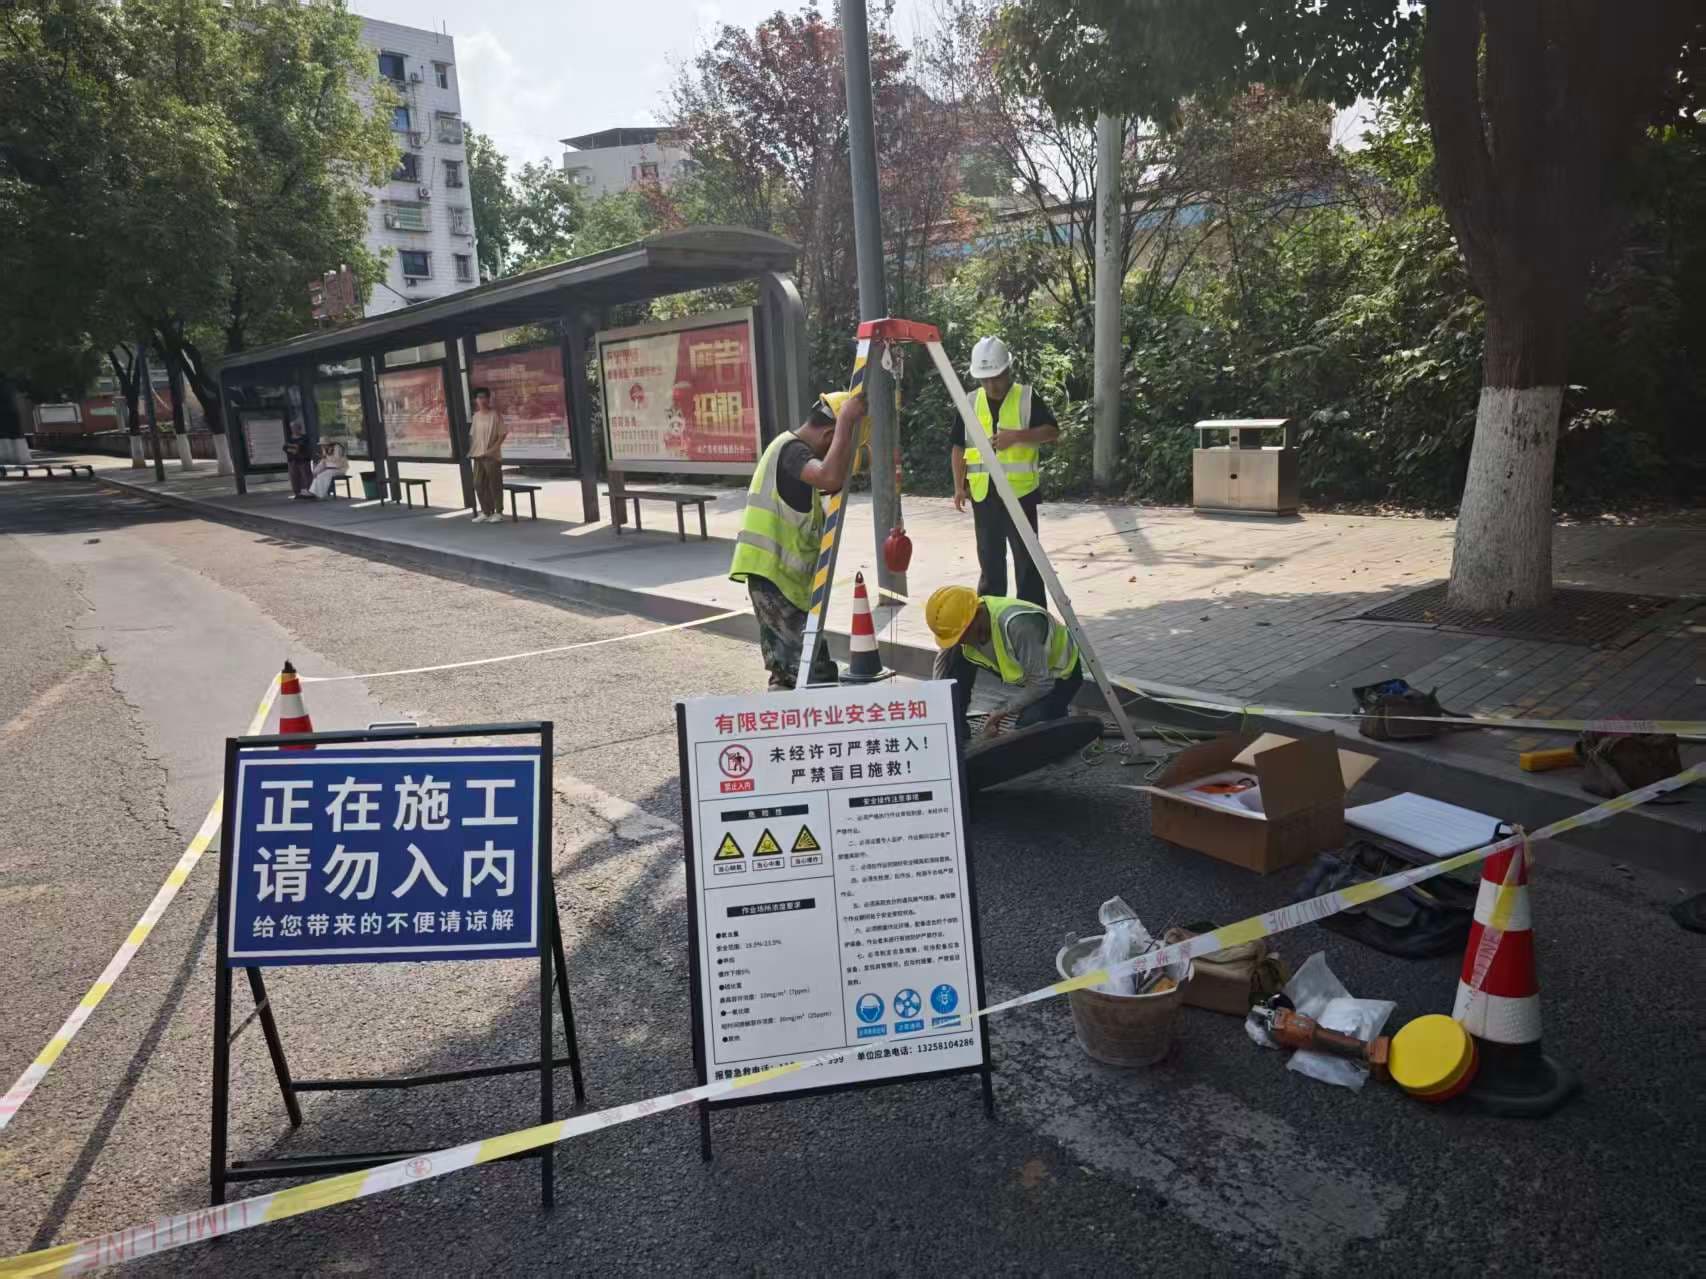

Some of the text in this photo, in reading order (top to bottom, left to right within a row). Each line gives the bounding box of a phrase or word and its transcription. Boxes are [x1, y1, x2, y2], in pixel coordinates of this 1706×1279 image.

[714, 701, 928, 734] 有限空间作业安全告知
[769, 736, 930, 764] 未经许可严禁进入！
[791, 760, 912, 785] 严禁盲目施救！
[256, 775, 519, 832] 正在施工
[253, 841, 516, 903] 请勿入内
[252, 909, 515, 938] 给您带来的不便请谅解
